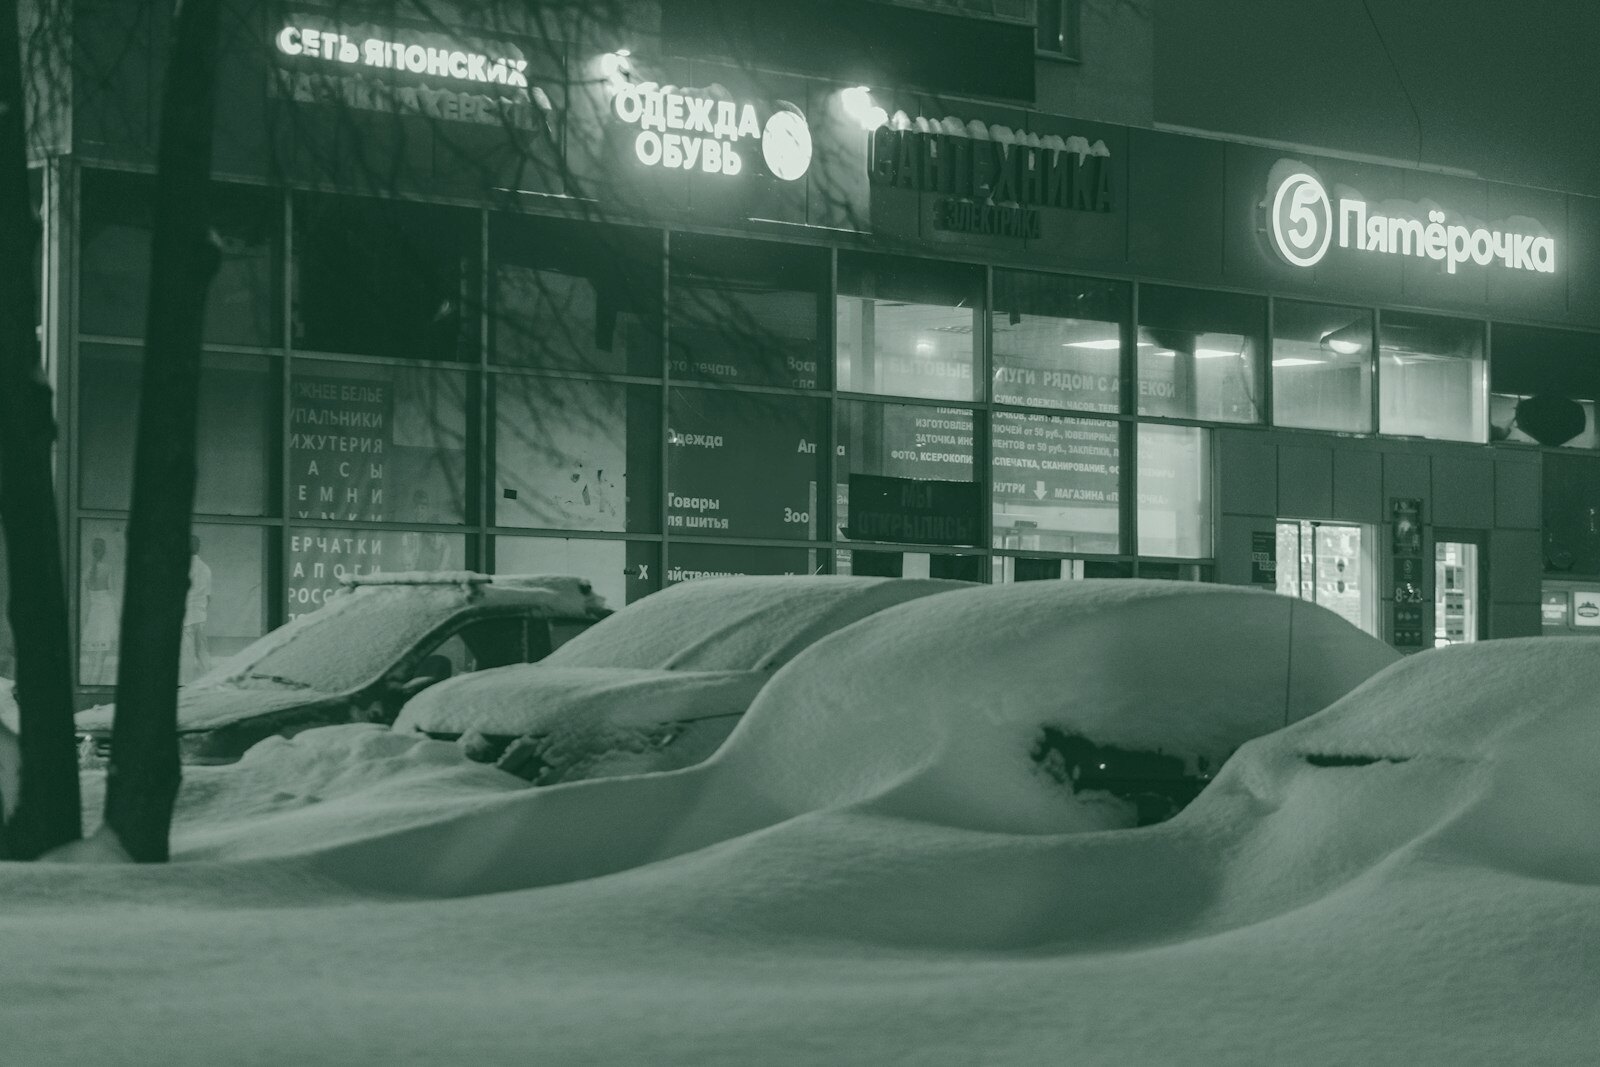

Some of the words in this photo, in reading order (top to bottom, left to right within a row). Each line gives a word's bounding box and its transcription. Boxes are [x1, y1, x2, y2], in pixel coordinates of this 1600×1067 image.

[277, 27, 358, 63] СЕТЬ
[365, 39, 528, 87] ЯПОНСКИХ
[616, 86, 760, 140] ОДЕЖДА
[635, 130, 742, 176] ОБУВЬ
[868, 124, 1112, 213] САНТЕХНИКА
[1339, 198, 1555, 274] Пятёрочка
[786, 356, 816, 373] Вост
[1043, 370, 1092, 391] РЯДОМ
[1097, 376, 1107, 391] С
[291, 383, 338, 400] ЖНЕЕ
[341, 385, 383, 403] БЕЛЬЕ
[289, 408, 383, 429] ПАЛЬНИКИ
[915, 418, 973, 431] ИЗГОТОВЛЕН
[992, 424, 1021, 435] ЛЮЧЕЙ
[1034, 427, 1043, 436] 50
[289, 433, 383, 453] ИЖУТЕРИЯ
[667, 428, 723, 448] Одежда
[915, 433, 956, 444] ЗАТОЧКА
[1037, 442, 1046, 451] 50
[307, 460, 382, 479] АСЫ
[891, 450, 919, 462] ФОТО,
[992, 457, 1039, 470] СПЕЧАТКА,
[1041, 460, 1107, 475] СКАНИРОВАНИЕ,
[297, 485, 382, 504] ЕМНИ
[993, 482, 1025, 494] НУТРИ
[1054, 488, 1103, 501] МАГАЗИНА
[668, 492, 719, 512] Товары
[667, 515, 683, 527] ля
[686, 516, 729, 529] шитья
[783, 507, 809, 523] Зоо
[290, 536, 381, 555] ЕРЧАТКИ
[292, 562, 381, 579] АПОГИ
[288, 587, 332, 605] РОСС
